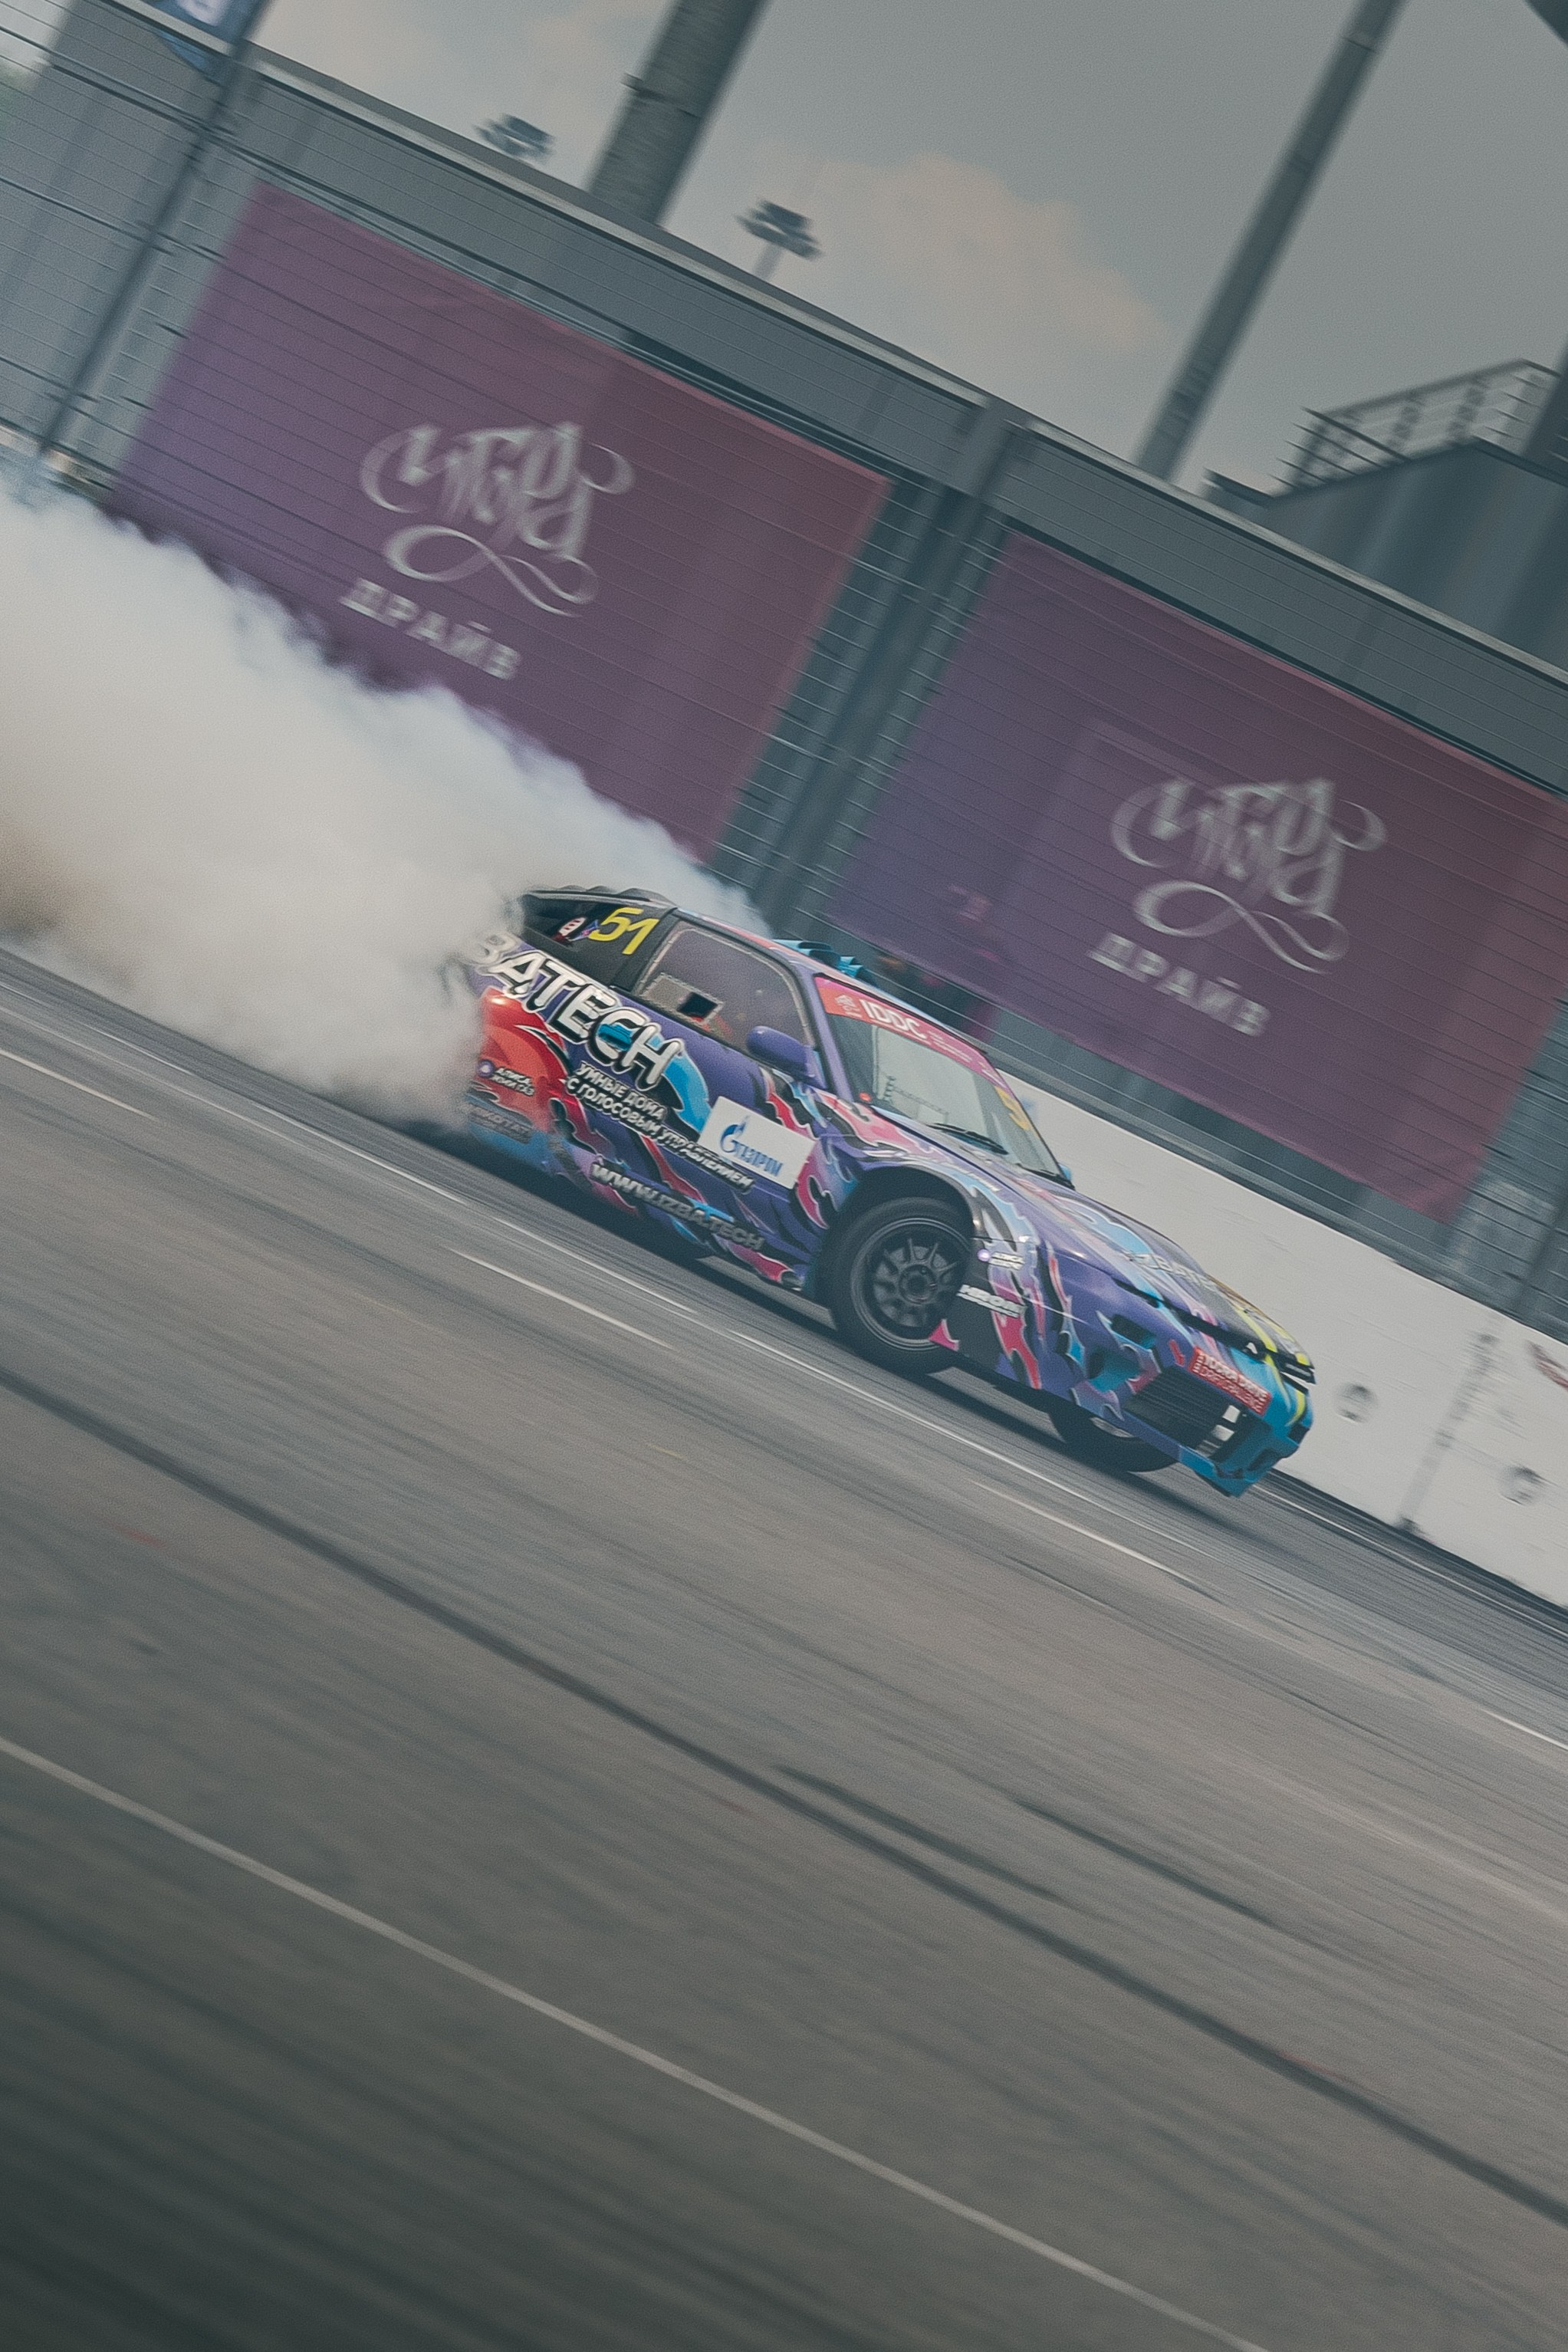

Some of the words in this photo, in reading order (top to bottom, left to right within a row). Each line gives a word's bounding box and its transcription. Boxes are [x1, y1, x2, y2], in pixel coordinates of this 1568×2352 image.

[588, 906, 660, 956] 51
[860, 999, 926, 1038] IDDC
[576, 1062, 626, 1097] УМНЫЕ
[623, 1091, 665, 1120] ДОМА
[578, 1084, 660, 1135] ГОЛОСОВЫМ
